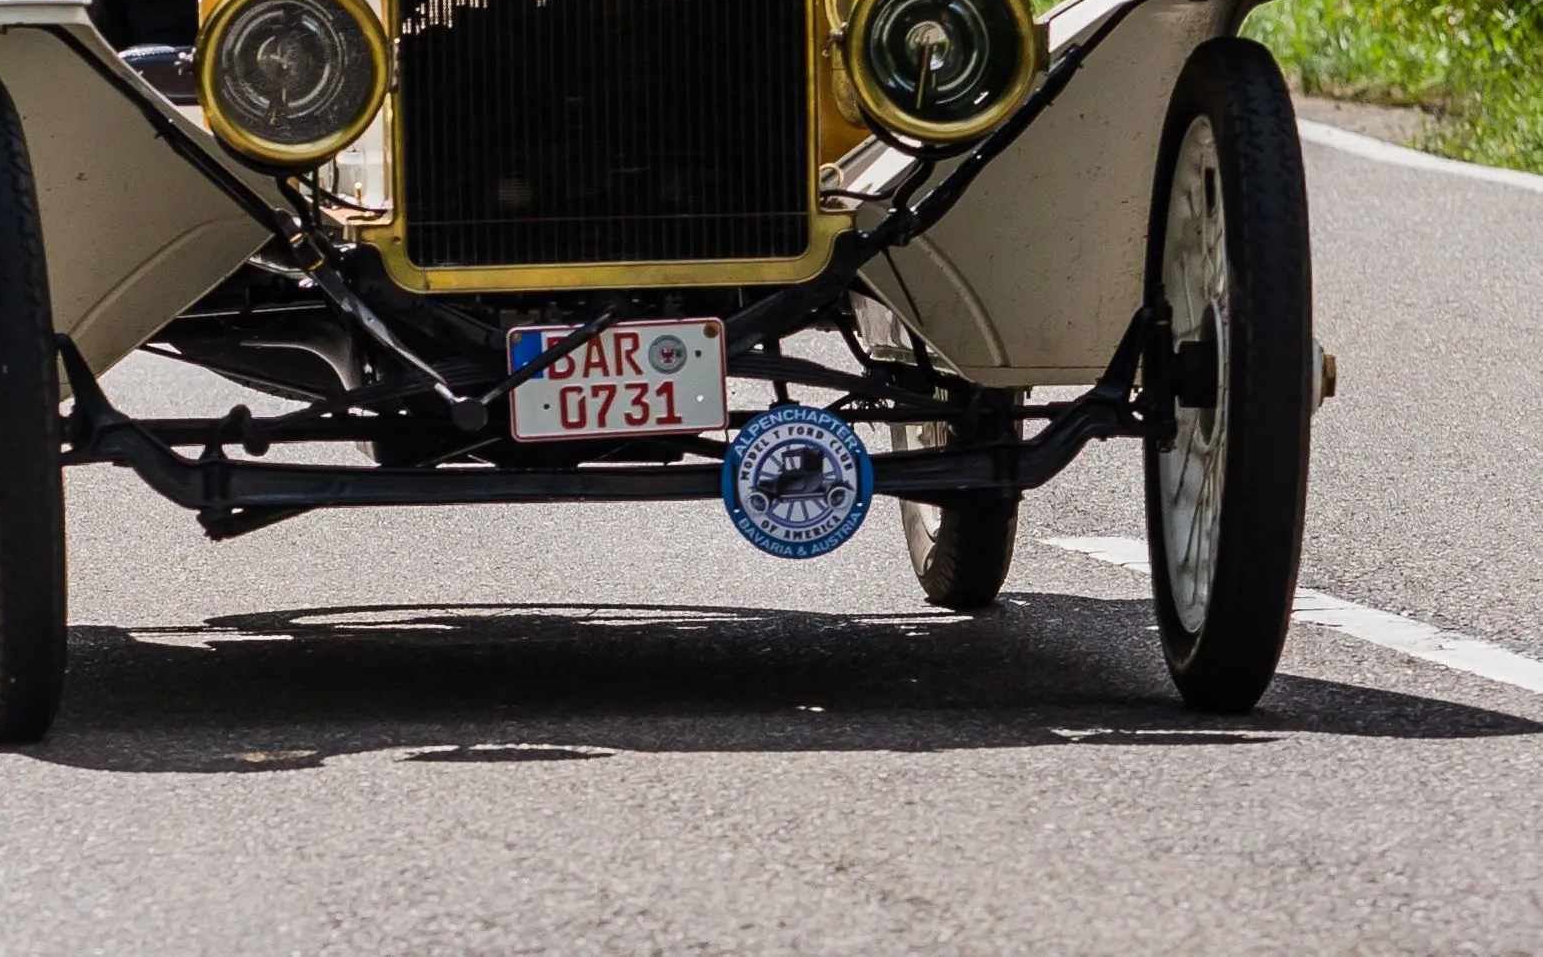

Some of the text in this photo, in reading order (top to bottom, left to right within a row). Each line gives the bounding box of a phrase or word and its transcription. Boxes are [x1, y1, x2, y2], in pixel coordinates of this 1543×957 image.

[546, 332, 644, 380] BAR
[559, 381, 683, 430] 0731
[734, 409, 858, 459] ALPENCHAPTER
[740, 426, 853, 481] MODEL T FORD CLUB
[738, 512, 862, 556] BAVARIA & AUSTRIA
[760, 515, 841, 540] OF AMERICA
